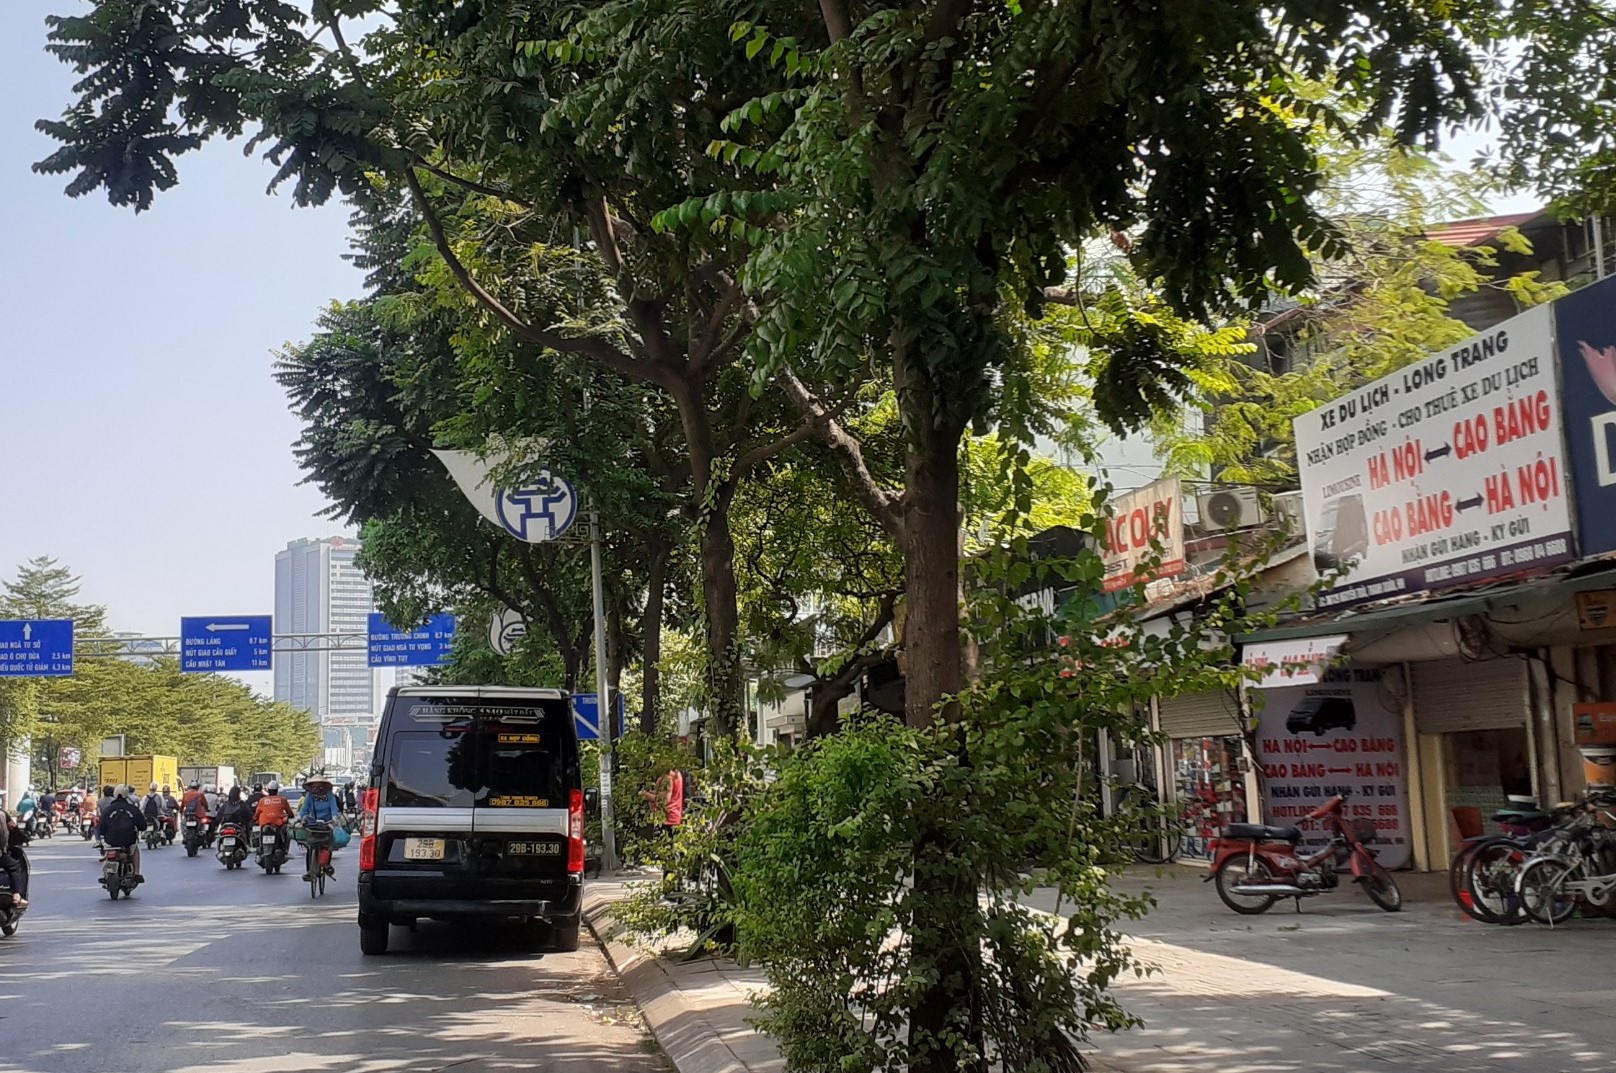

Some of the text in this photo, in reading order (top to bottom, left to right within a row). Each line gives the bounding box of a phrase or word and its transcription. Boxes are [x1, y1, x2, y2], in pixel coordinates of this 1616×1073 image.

[1320, 330, 1509, 431] XE DU LỊCH LONG TRANG
[1398, 406, 1422, 429] CHO
[1424, 386, 1459, 419] THUÊ
[1461, 382, 1479, 405] XE
[1481, 372, 1502, 396] DU
[1504, 356, 1540, 388] LỊCH
[1366, 387, 1550, 490] HÀ NỘI CAO BẰNG
[1374, 451, 1560, 546] CAO BẰNG HÀ NỘI
[206, 636, 221, 645] LÁNG
[62, 652, 70, 660] km
[1333, 738, 1356, 752] CAO
[1263, 764, 1287, 778] CAO
[416, 838, 434, 848] 29B
[510, 842, 560, 854] 29B-193.30
